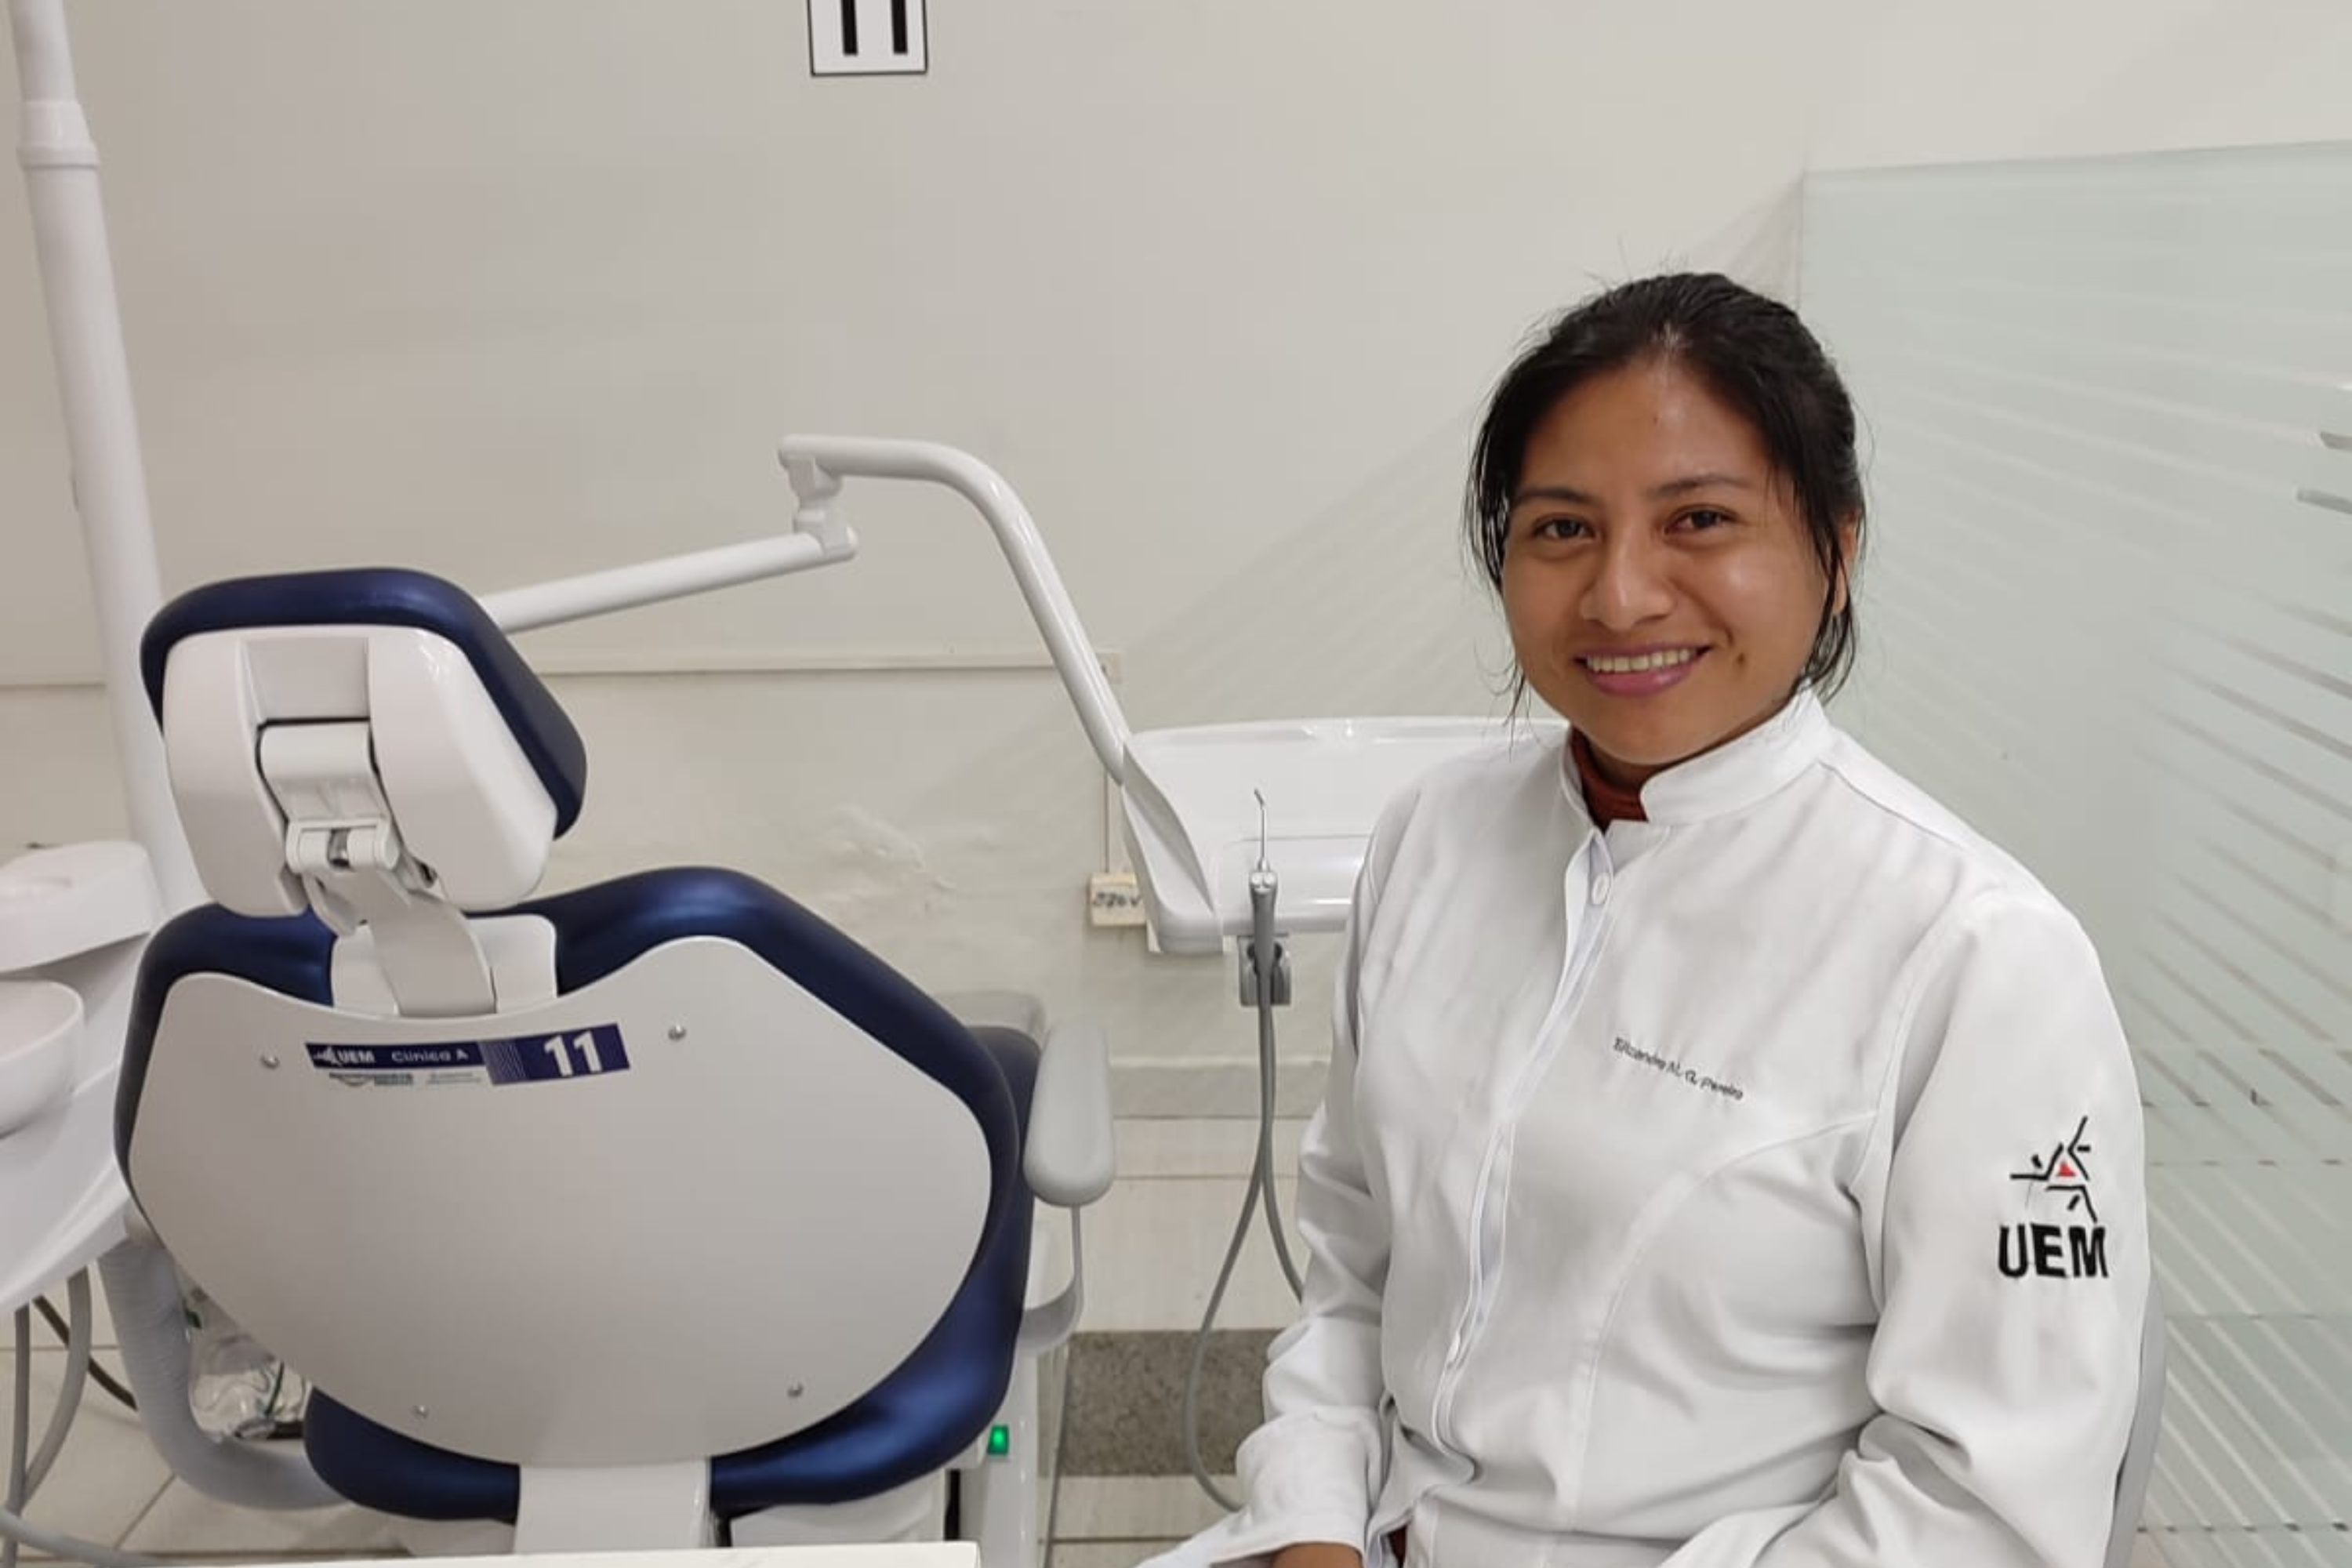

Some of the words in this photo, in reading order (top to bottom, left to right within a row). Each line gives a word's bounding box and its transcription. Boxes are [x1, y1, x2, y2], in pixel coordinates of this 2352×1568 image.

[337, 1050, 376, 1064] UEM
[456, 1048, 470, 1061] A
[544, 1030, 604, 1077] 11
[1998, 1223, 2109, 1278] UEM
